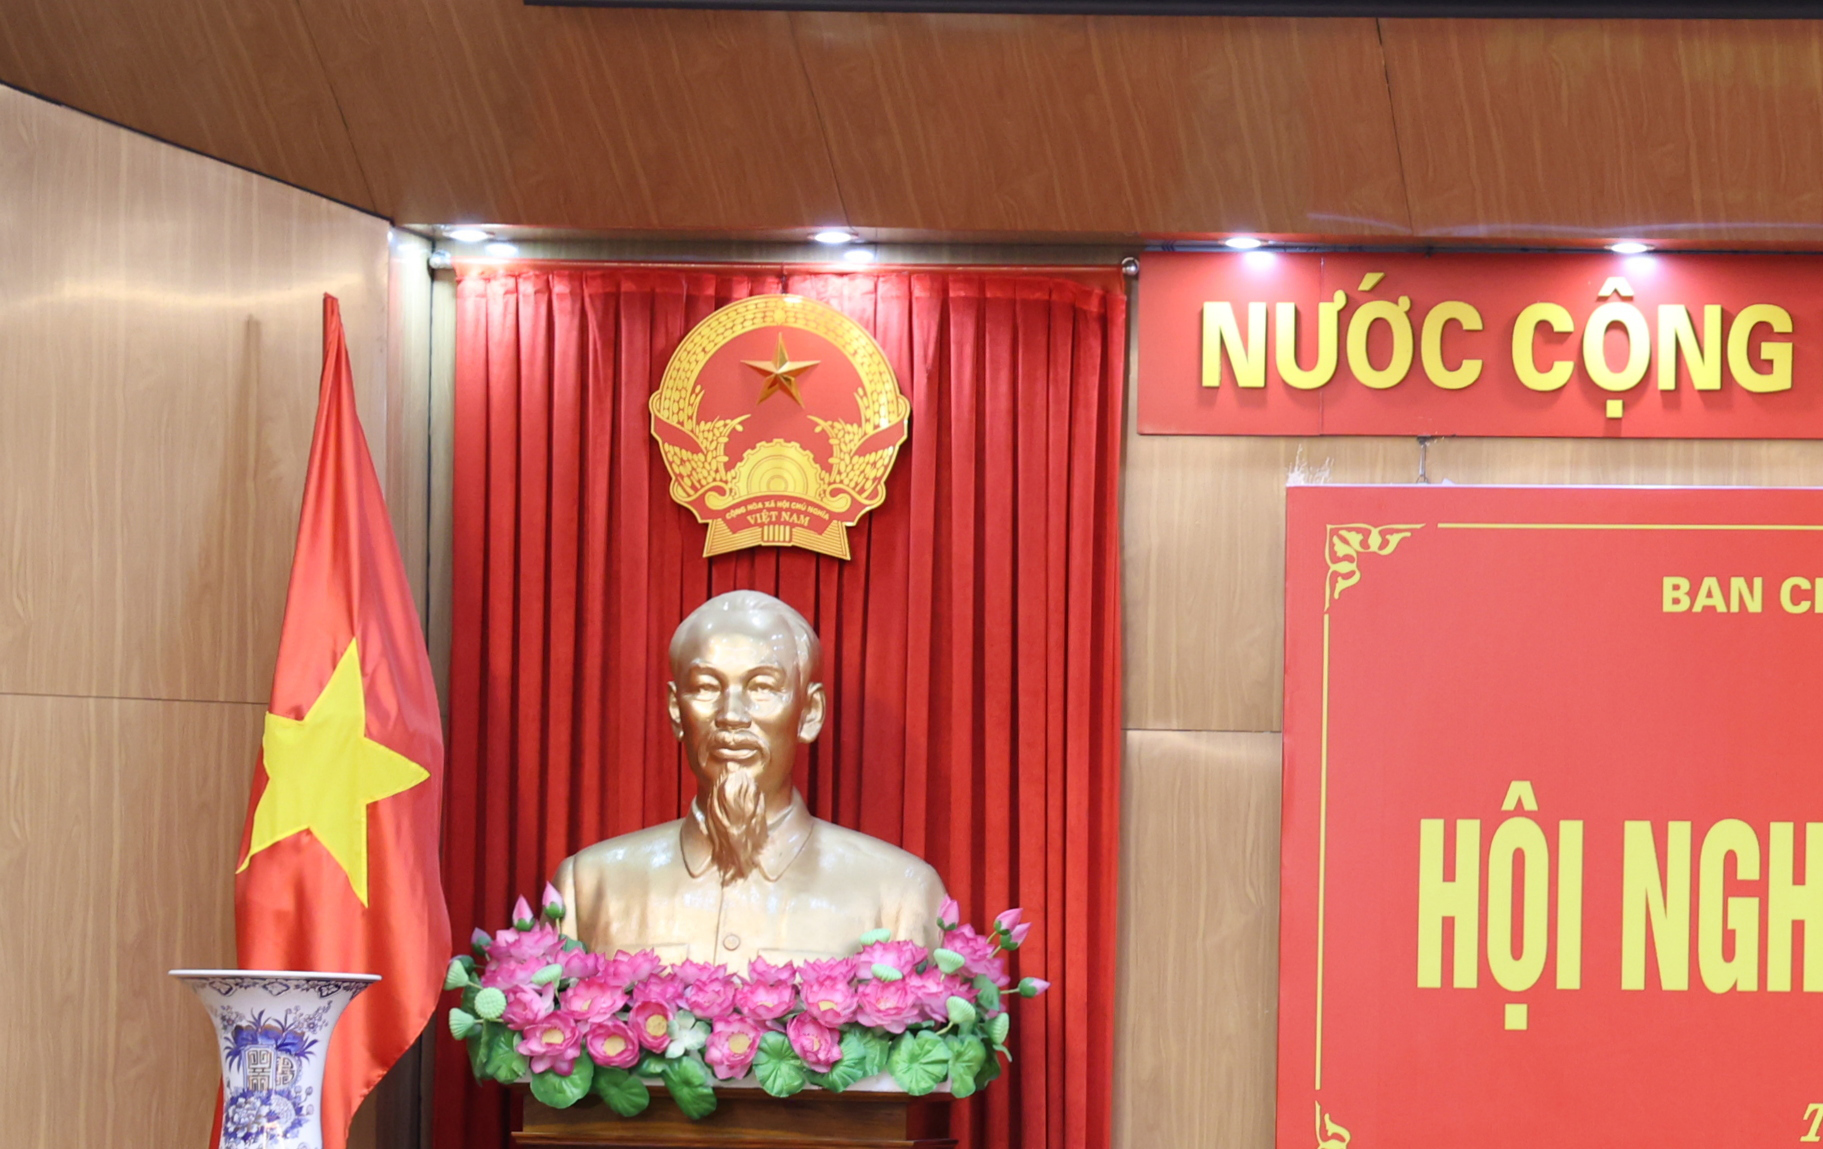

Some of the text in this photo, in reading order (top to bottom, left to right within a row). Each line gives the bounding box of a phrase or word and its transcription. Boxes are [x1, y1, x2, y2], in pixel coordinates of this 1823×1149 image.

[1200, 272, 1483, 390] NƯỚC
[1510, 276, 1793, 419] CỘNG
[746, 509, 810, 526] VIỆT NAM
[1662, 576, 1764, 614] BAN
[1416, 780, 1585, 1031] HỘI
